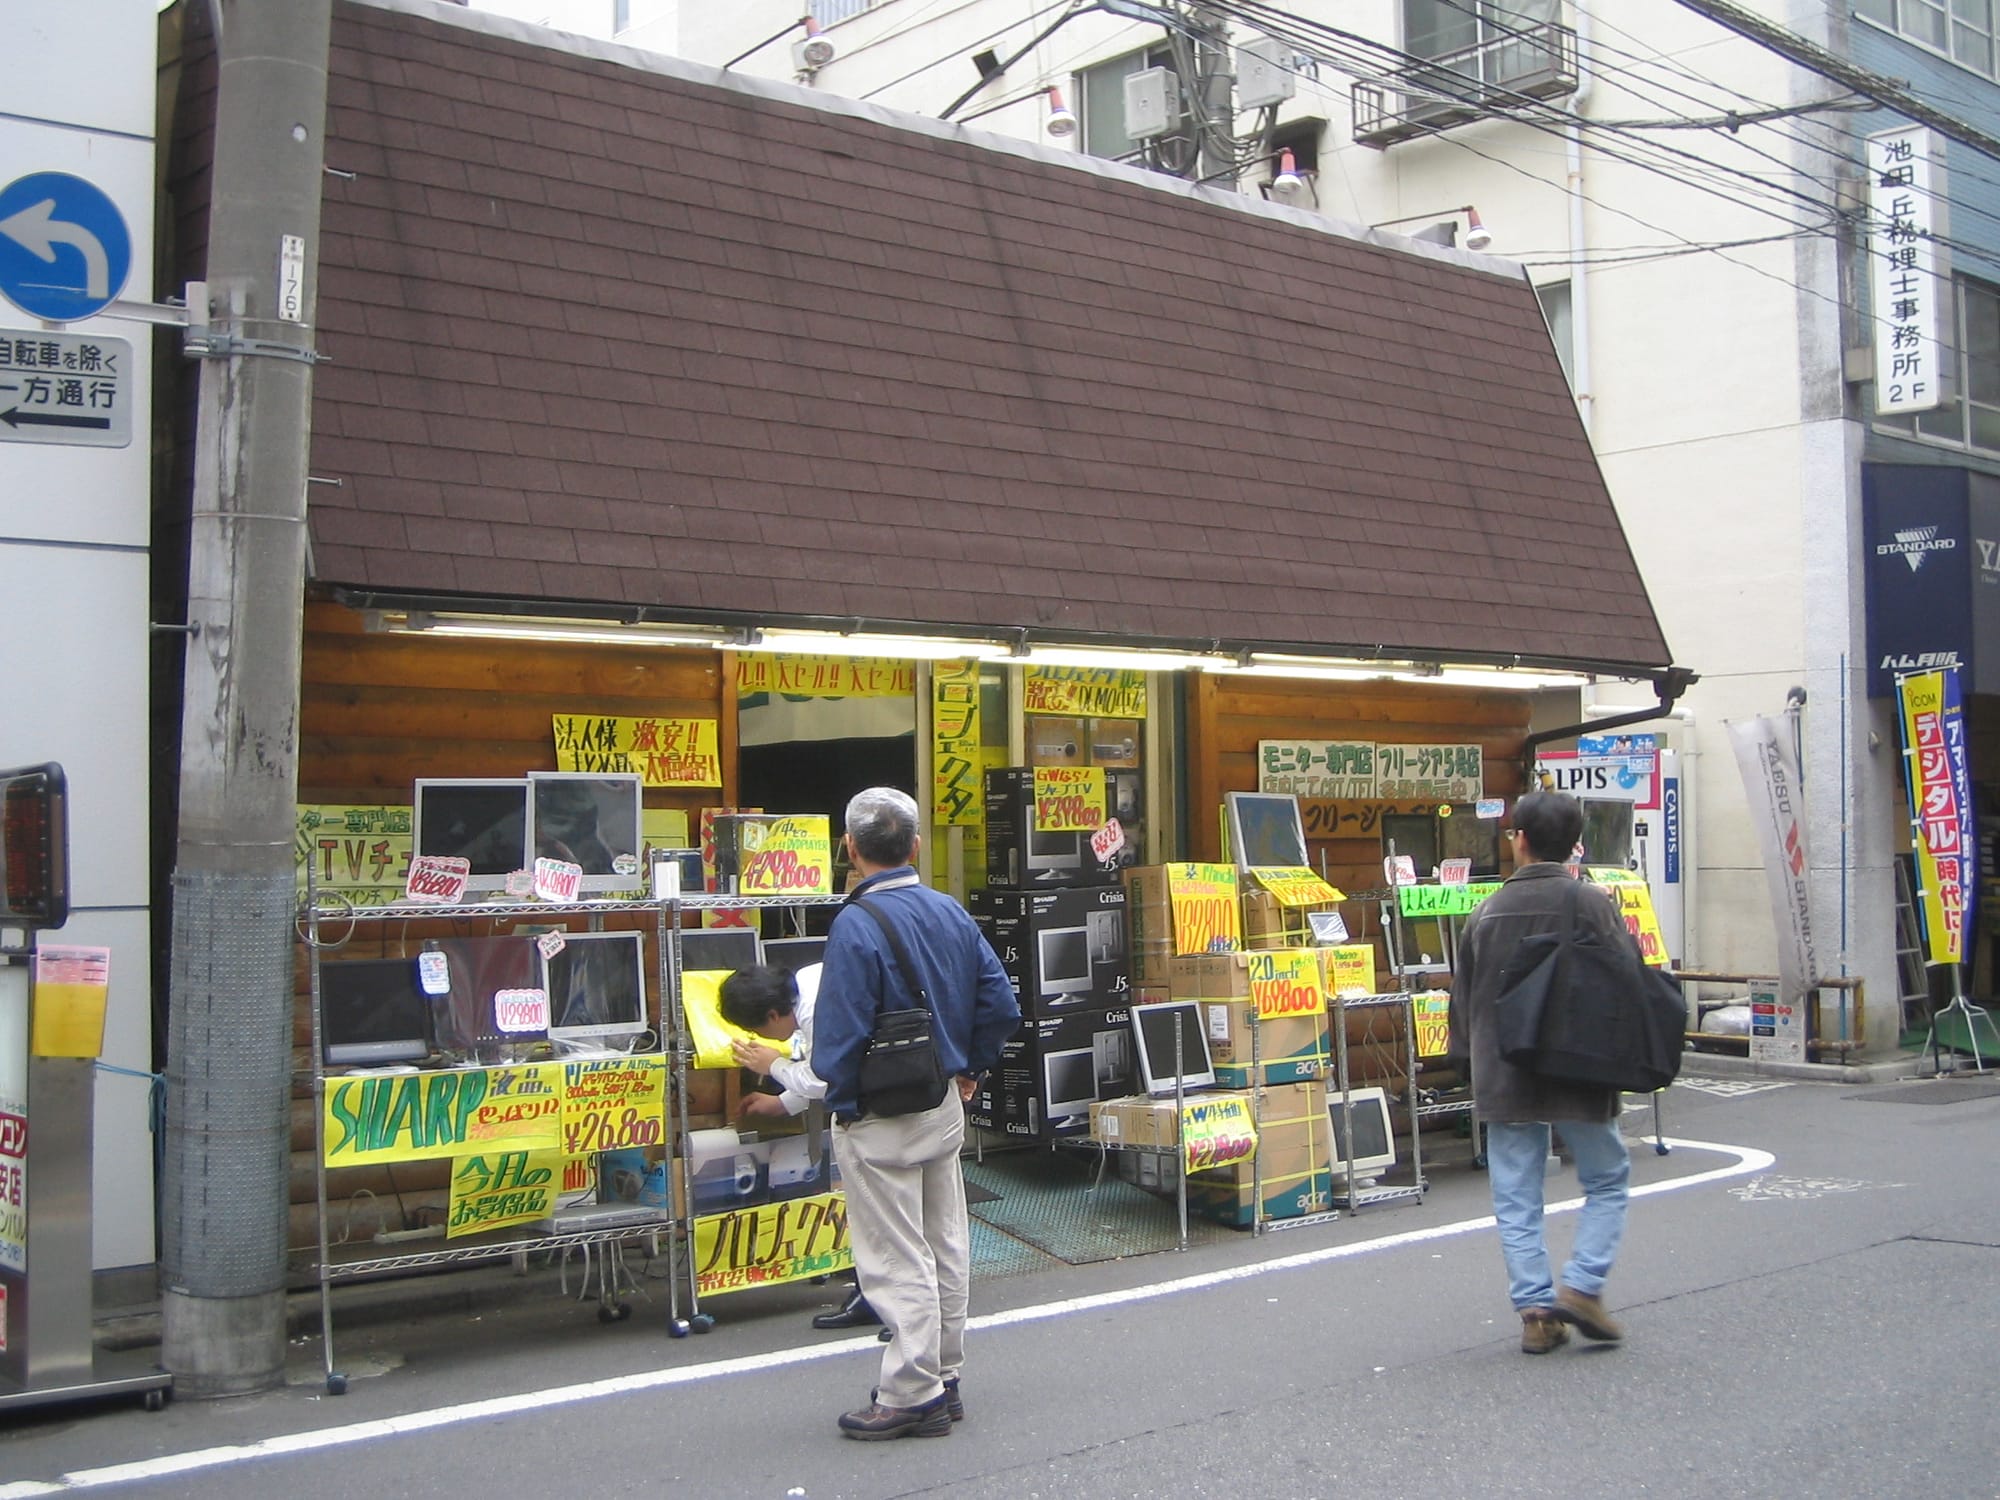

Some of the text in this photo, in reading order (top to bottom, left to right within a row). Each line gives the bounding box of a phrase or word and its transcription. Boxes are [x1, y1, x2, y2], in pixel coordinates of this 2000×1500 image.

[285, 264, 298, 311] 176
[0, 334, 118, 373] 自転車を除く
[0, 375, 117, 409] 一方通行
[1889, 383, 1926, 403] 2F
[1876, 537, 1956, 556] STANDARD
[1880, 650, 1959, 670] ハム月販
[555, 718, 699, 752] 法人様 激安!!
[1264, 745, 1374, 775] モニター専門店
[1557, 766, 1607, 791] LPIS
[1766, 737, 1792, 816] YAESU
[301, 808, 411, 834] ター専門店
[1665, 788, 1677, 853] CALPIS
[1099, 891, 1125, 904] Crisia
[330, 1071, 488, 1156] SHARP
[1006, 1121, 1029, 1134] Crisia
[455, 1151, 552, 1198] 今月の
